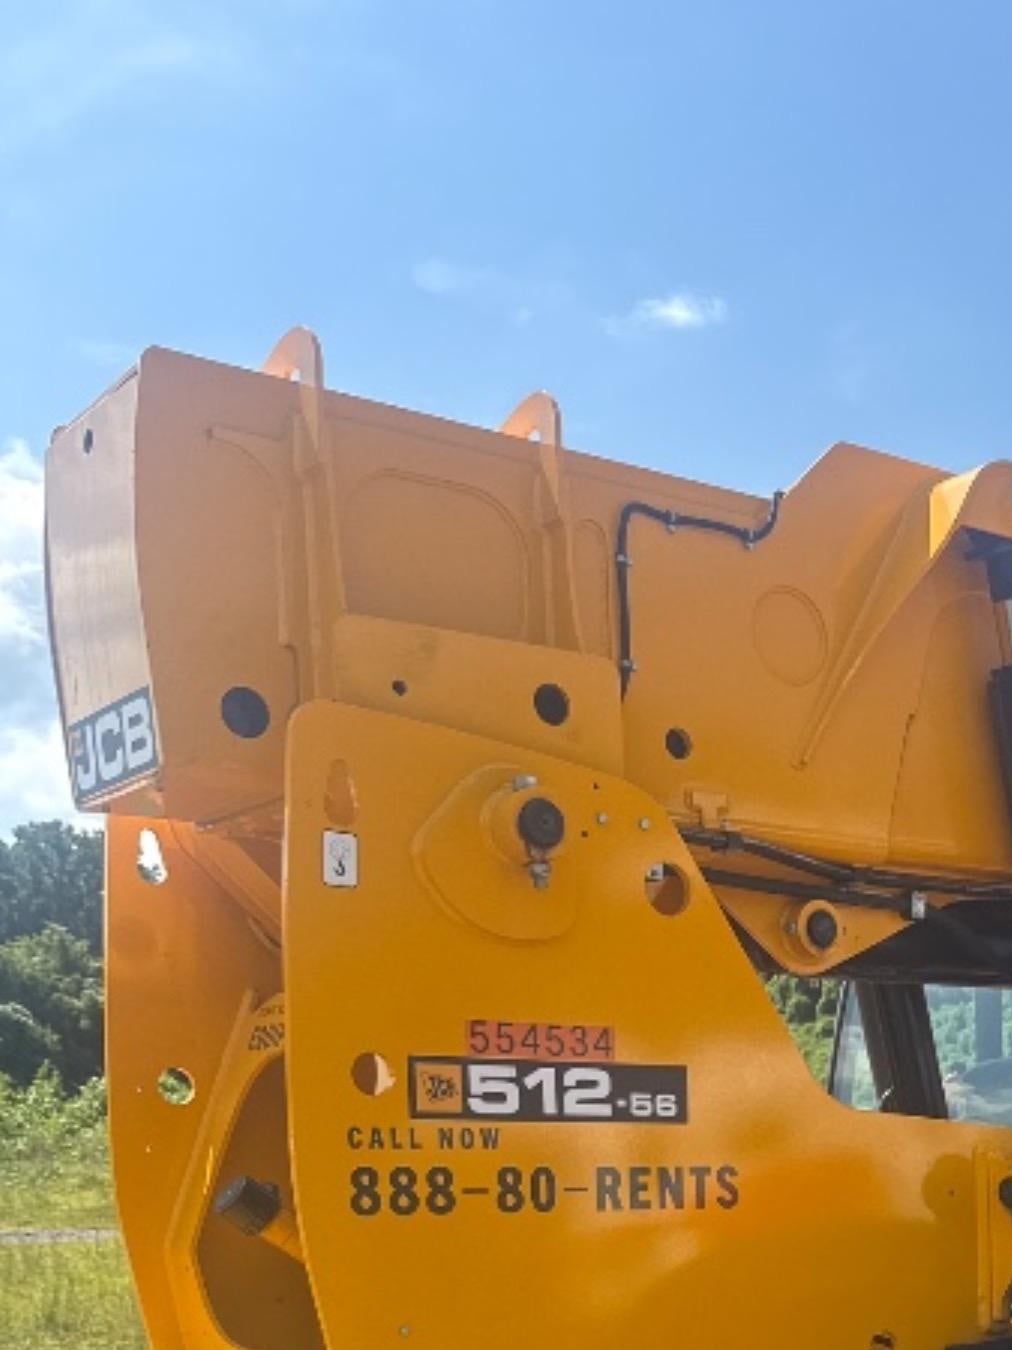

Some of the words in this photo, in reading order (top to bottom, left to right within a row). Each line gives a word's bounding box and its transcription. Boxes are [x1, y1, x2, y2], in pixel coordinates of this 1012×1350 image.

[77, 697, 154, 790] JCB
[469, 1019, 613, 1057] 554534
[347, 1127, 422, 1149] CALL
[438, 1127, 500, 1149] NOW
[350, 1165, 740, 1216] 888-80-RENTS
